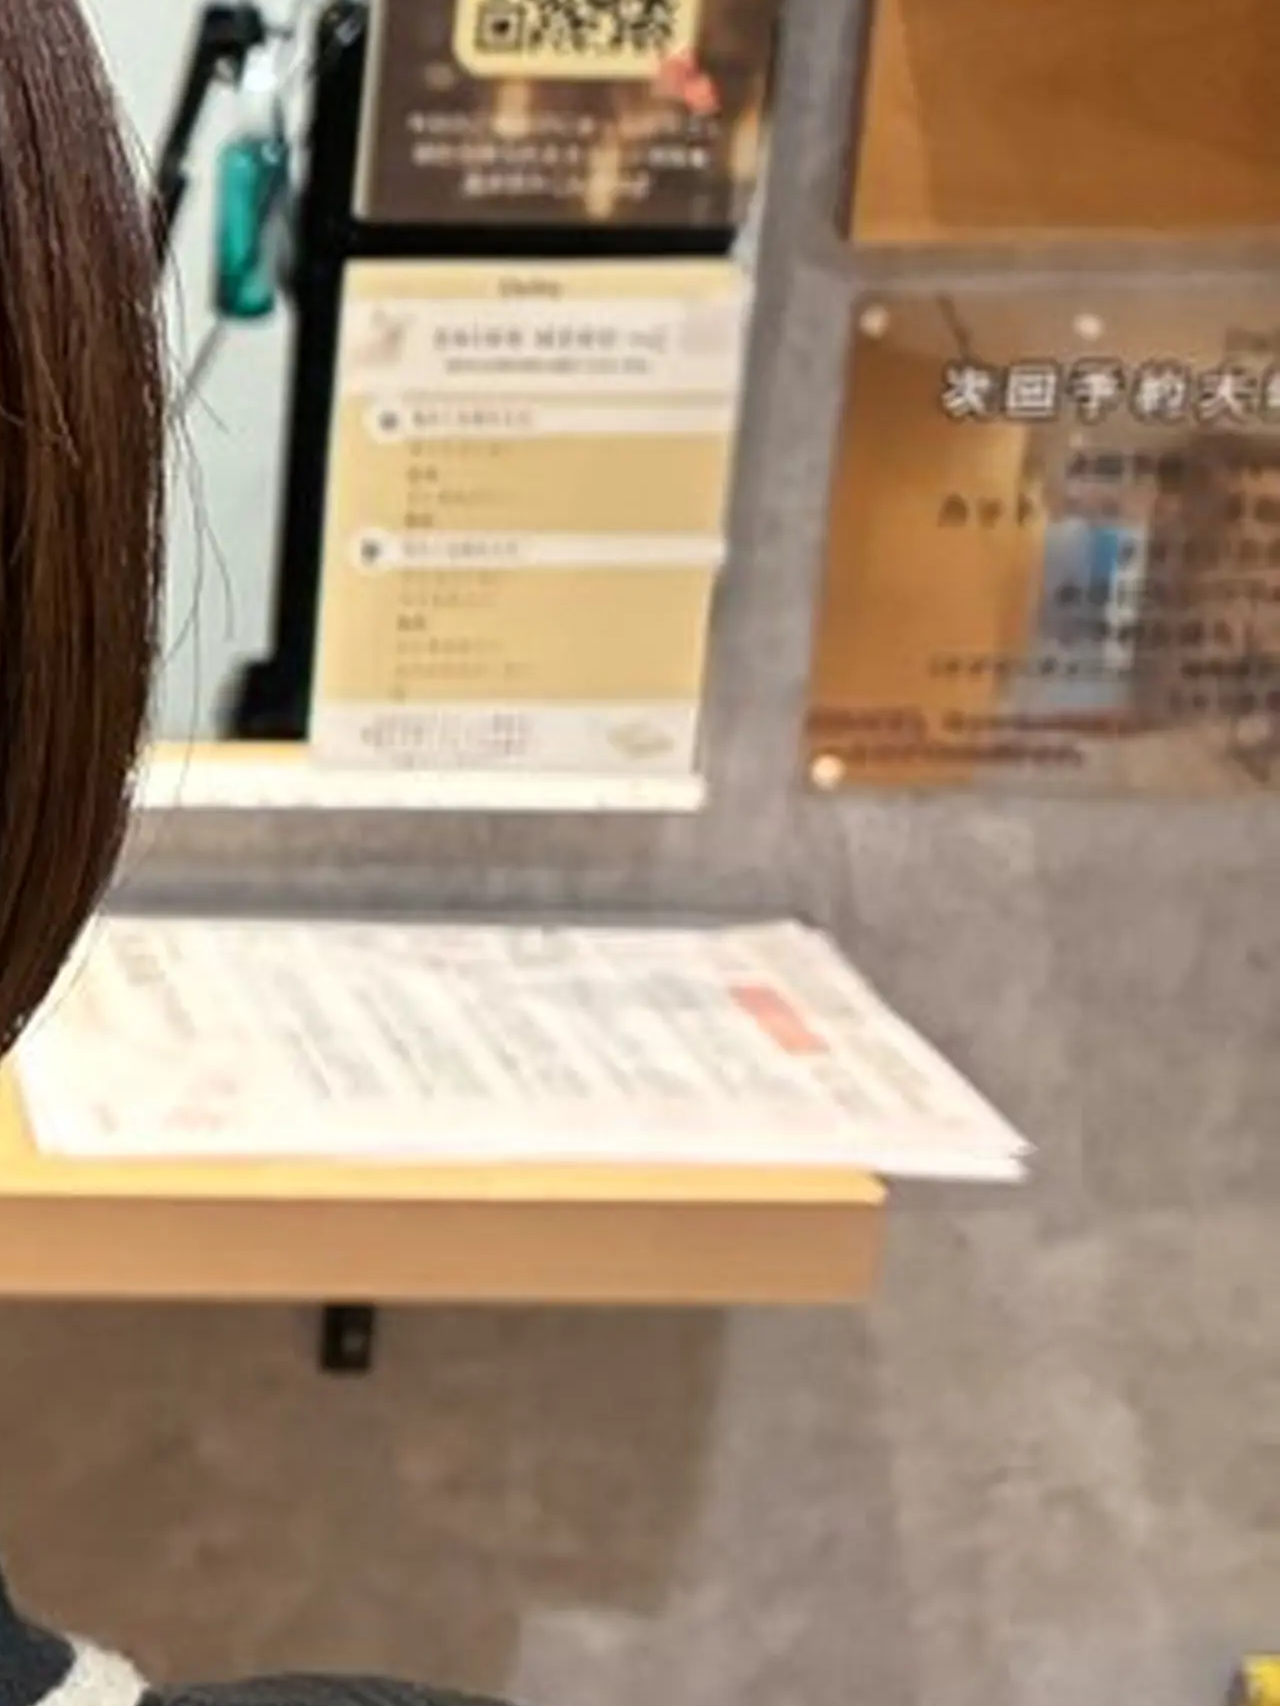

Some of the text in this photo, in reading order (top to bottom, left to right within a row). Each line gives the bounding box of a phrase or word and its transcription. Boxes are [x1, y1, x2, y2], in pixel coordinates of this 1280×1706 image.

[942, 365, 1280, 421] 次回予約大
